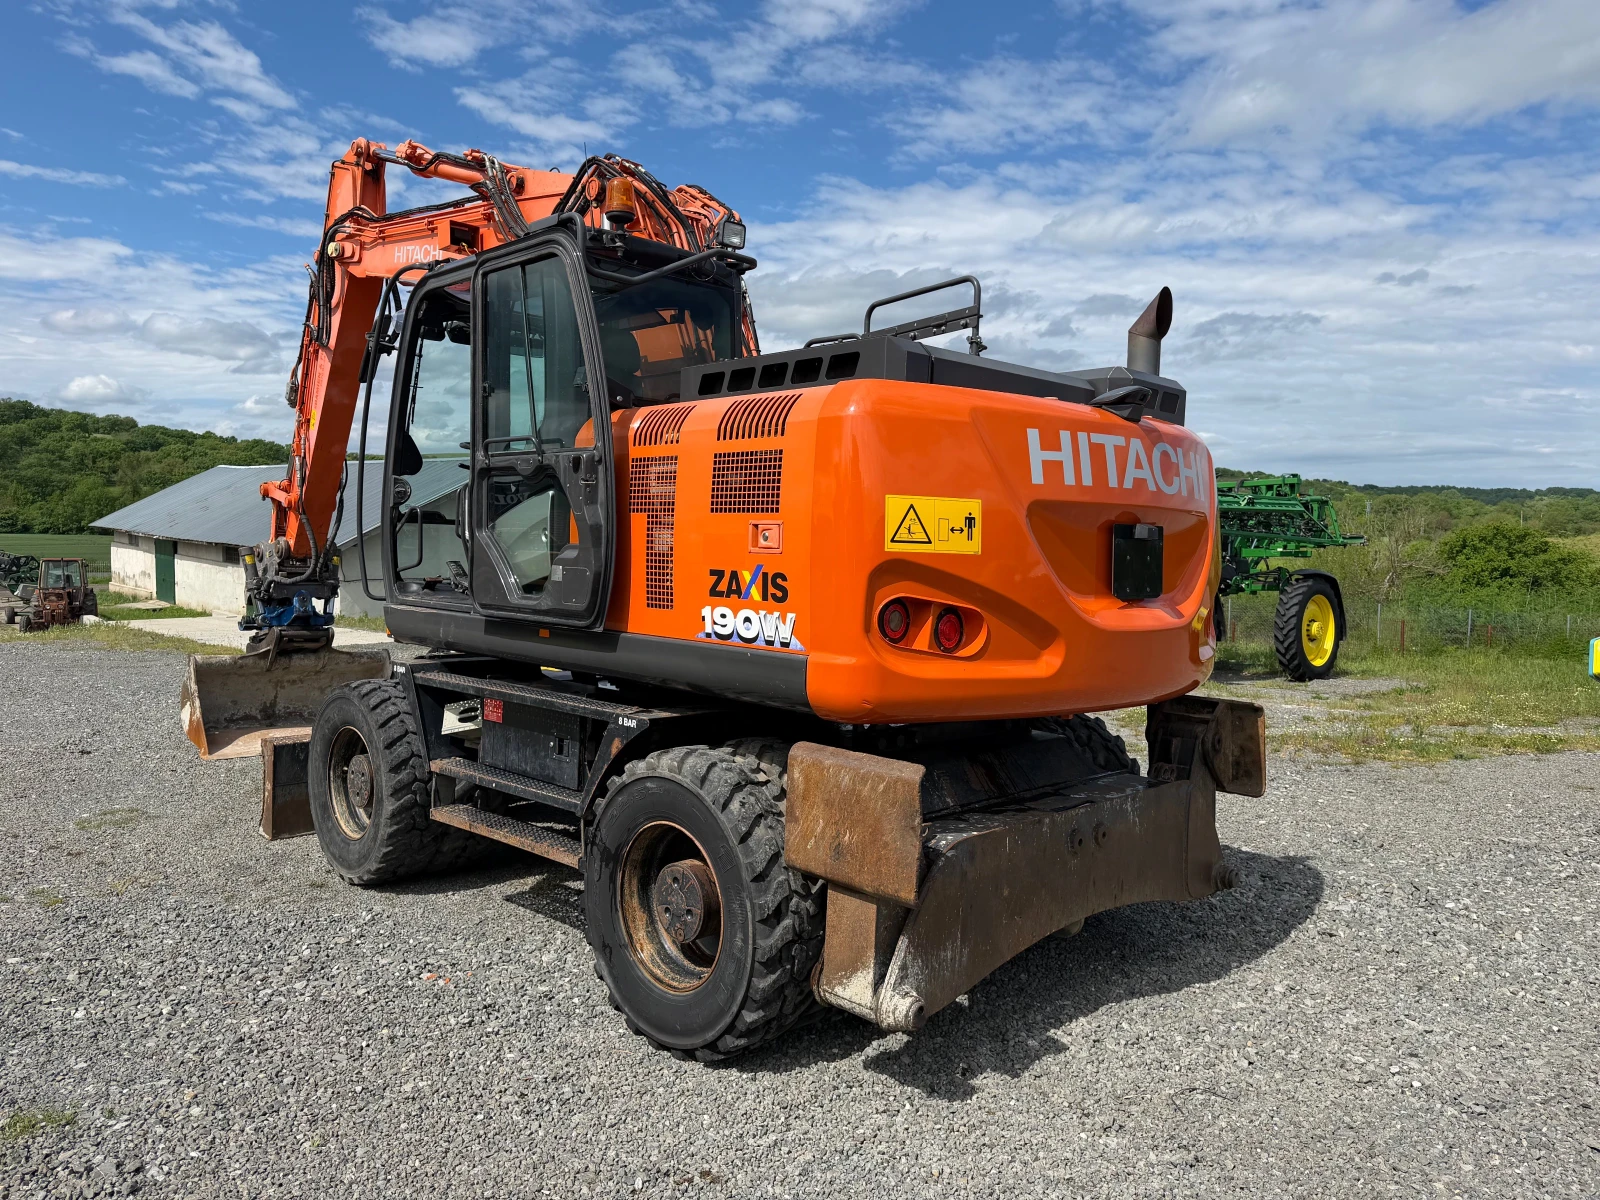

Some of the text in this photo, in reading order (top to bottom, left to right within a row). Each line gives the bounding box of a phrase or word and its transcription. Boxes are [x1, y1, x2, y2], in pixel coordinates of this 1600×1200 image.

[394, 244, 443, 263] HITACHI
[1026, 427, 1205, 501] HITACHI
[709, 564, 789, 604] ZAXIS
[701, 605, 797, 648] 190W
[618, 716, 637, 729] 8 BAR
